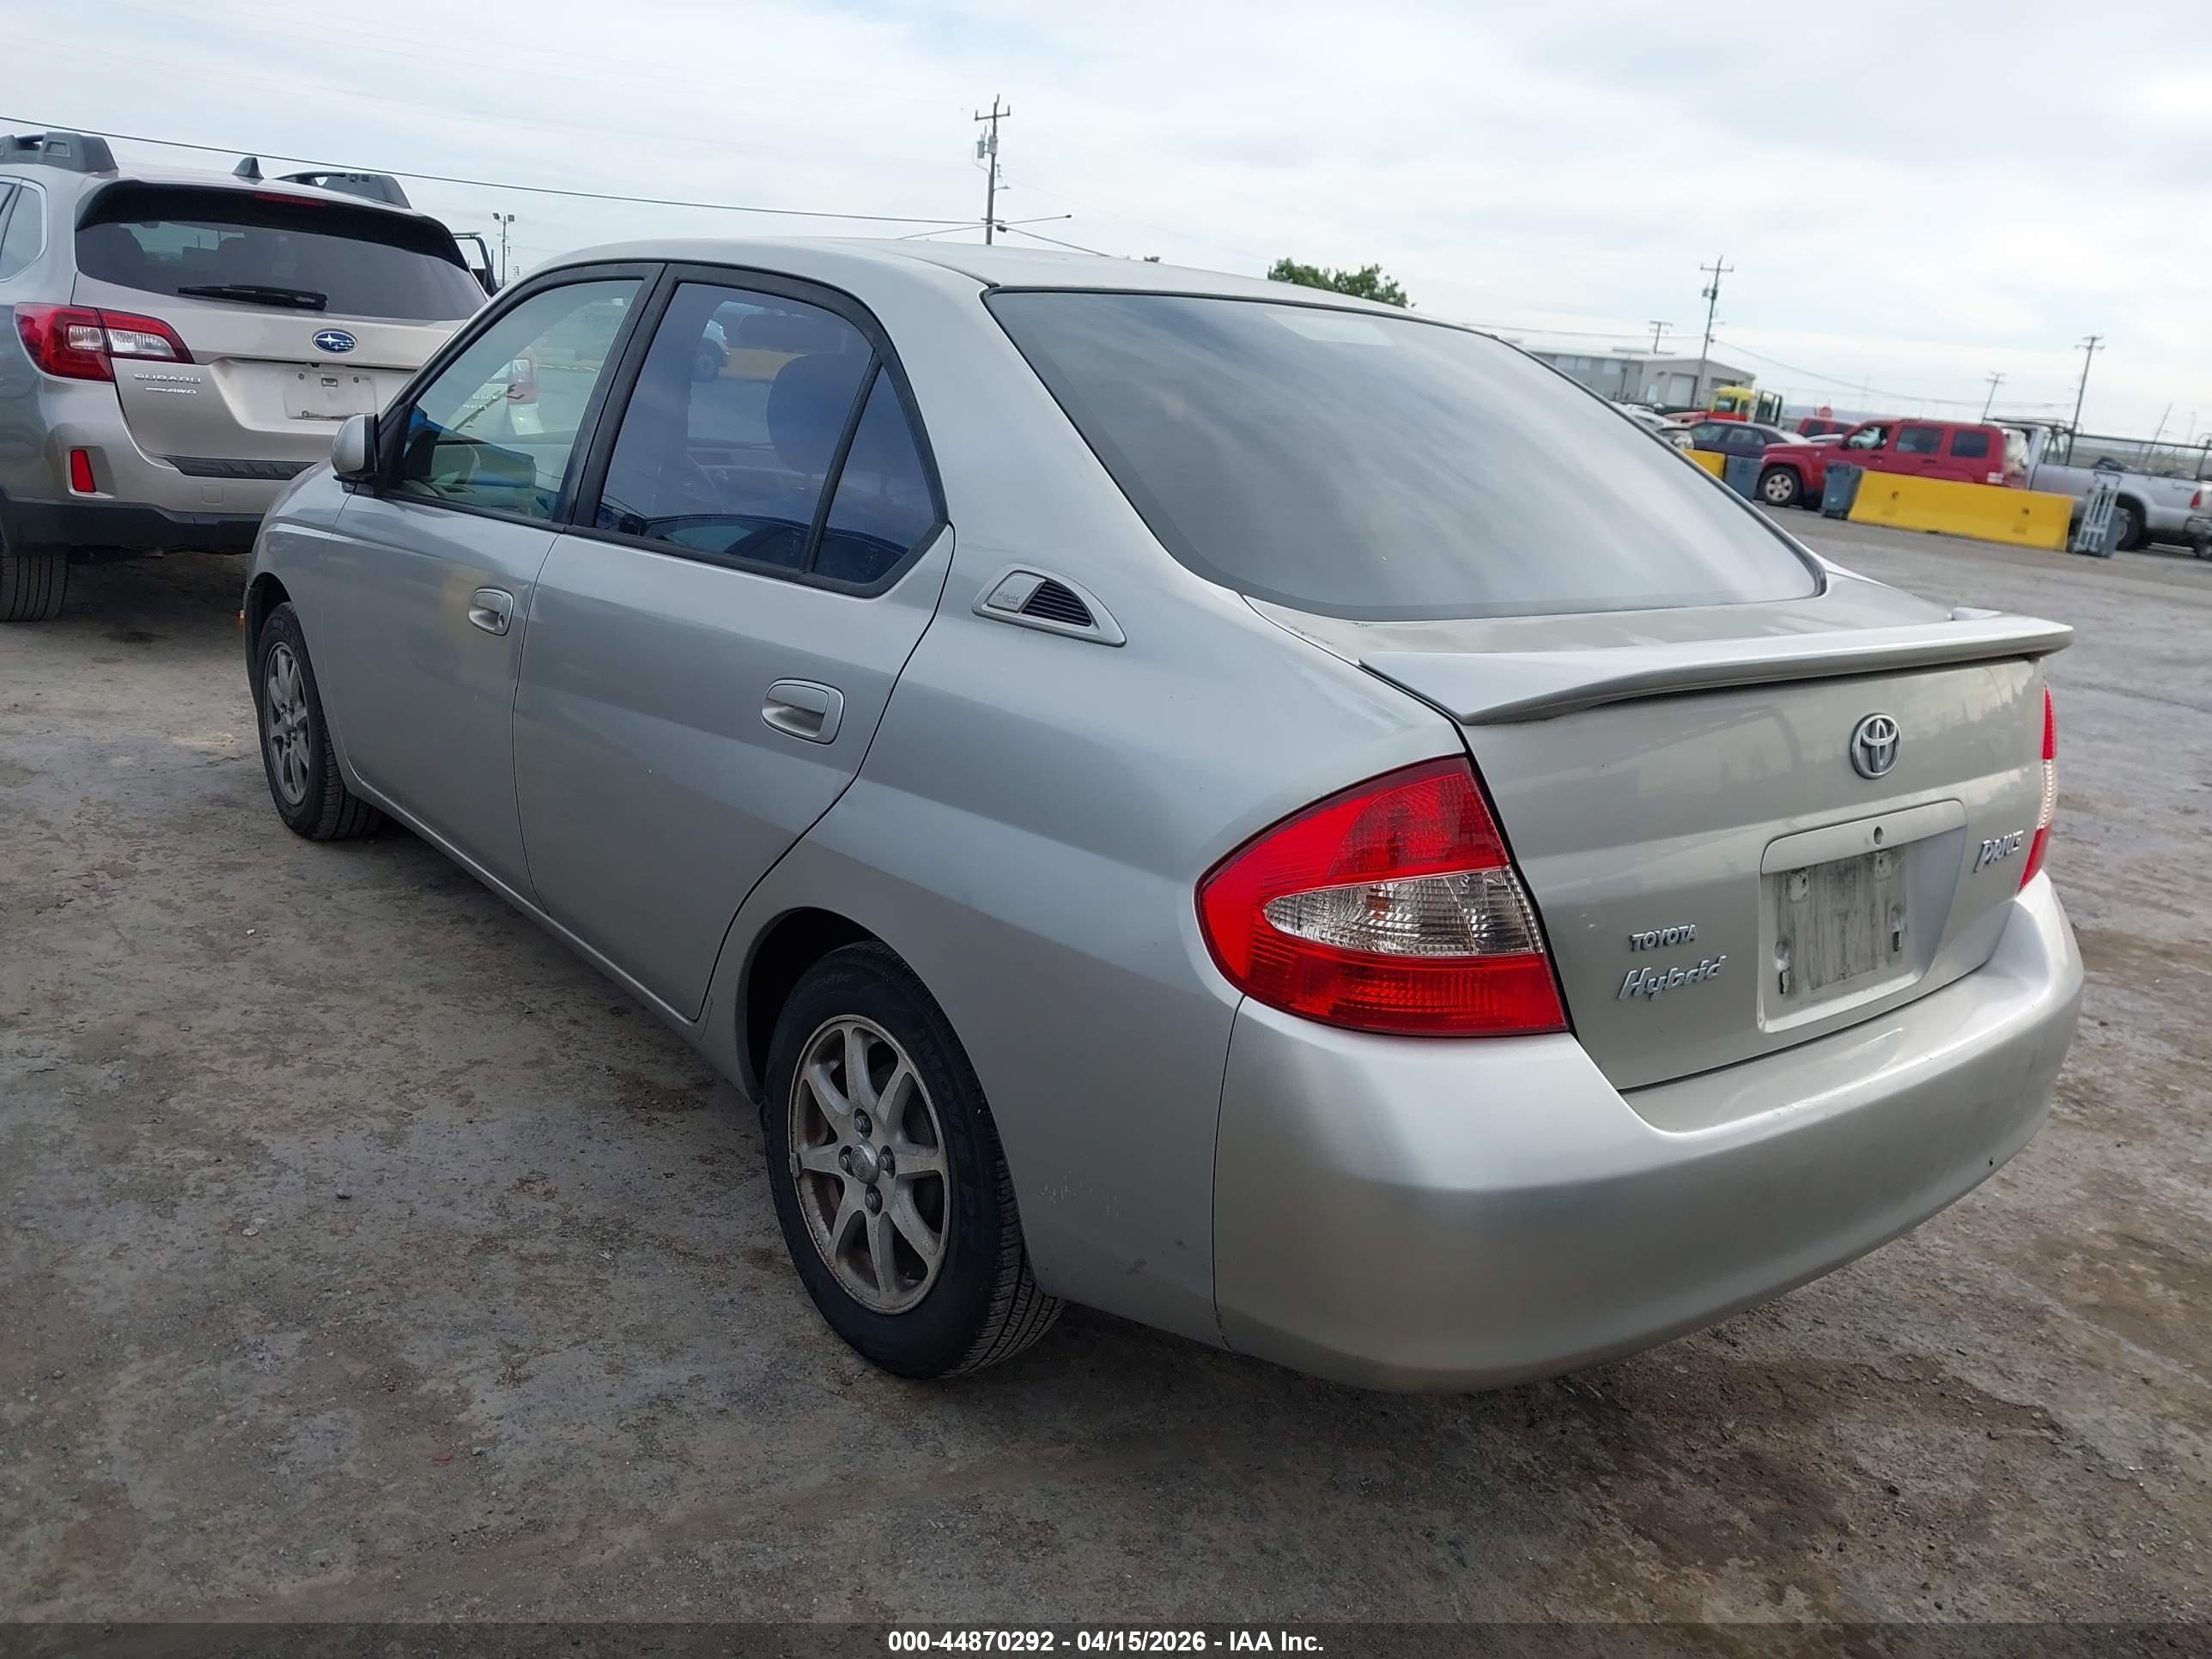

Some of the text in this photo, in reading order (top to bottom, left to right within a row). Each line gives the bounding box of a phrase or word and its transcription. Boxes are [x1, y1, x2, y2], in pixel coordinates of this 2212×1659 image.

[134, 374, 201, 384] SUBARU
[1630, 924, 1698, 951] TOYOTA
[1617, 955, 1728, 1001] Hybrid
